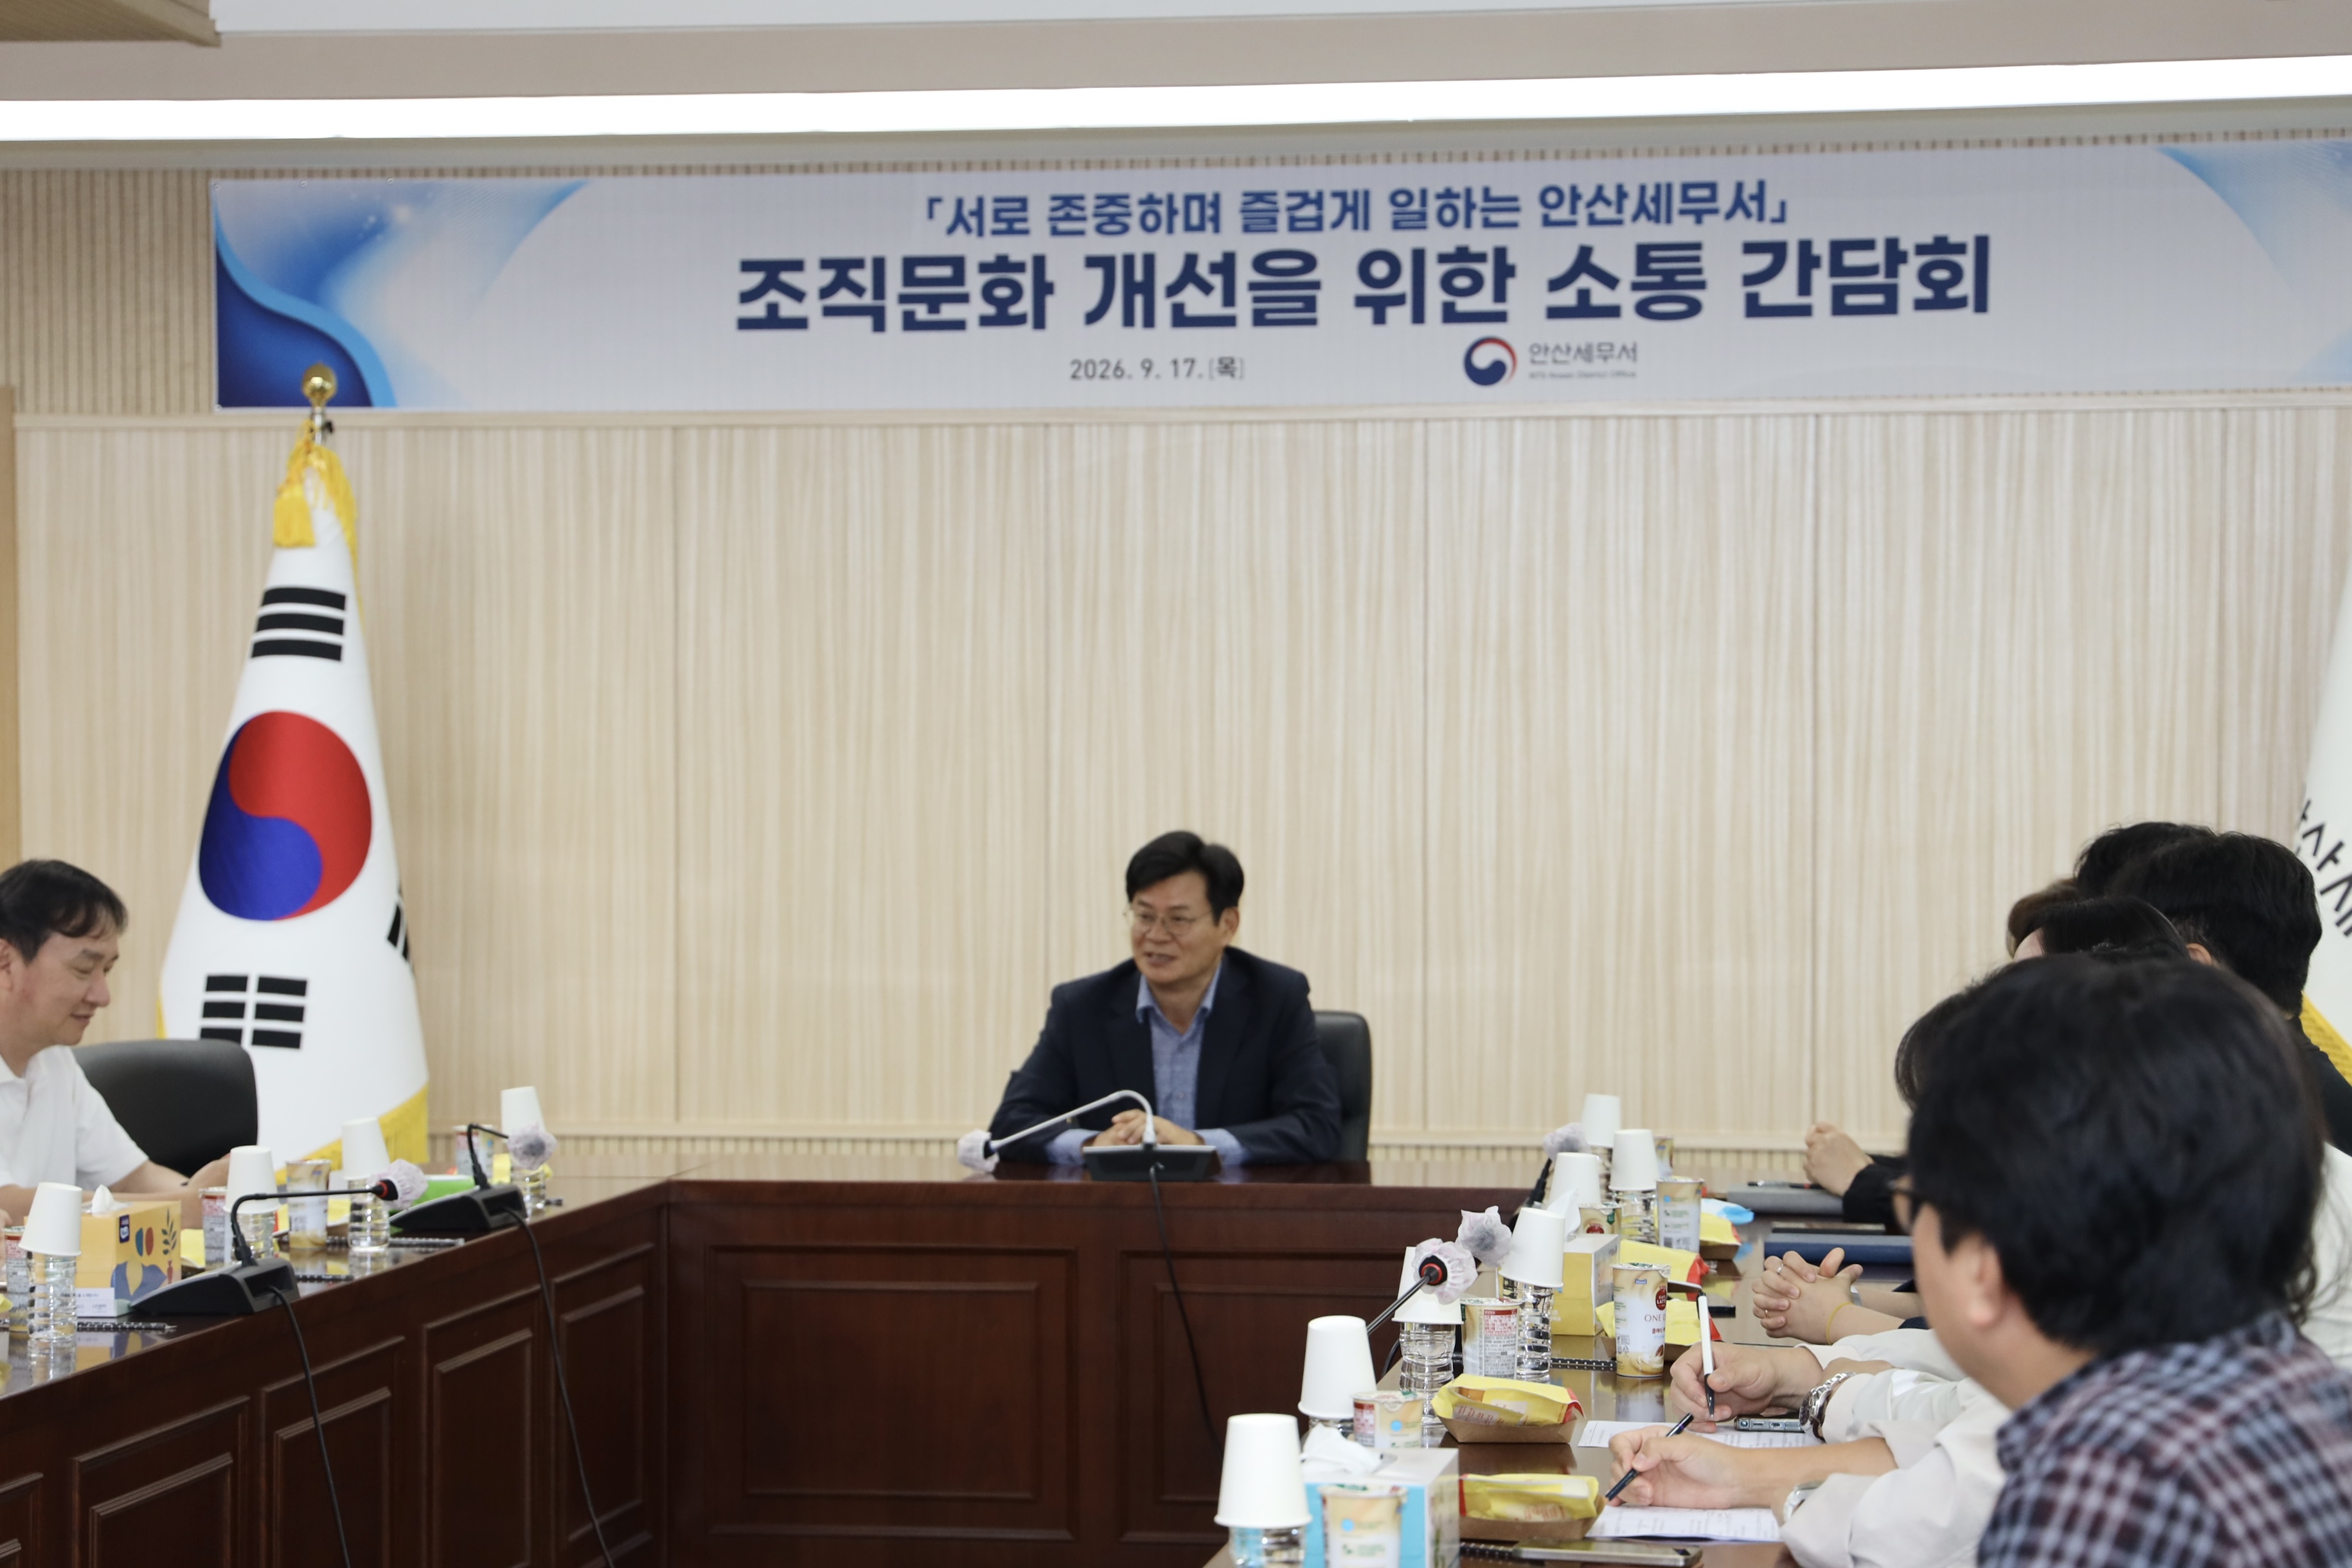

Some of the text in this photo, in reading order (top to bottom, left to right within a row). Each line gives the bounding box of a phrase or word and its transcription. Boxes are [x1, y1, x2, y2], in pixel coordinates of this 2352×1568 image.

[926, 179, 1788, 238] 「서로 존중하며 즐겁게 일하는 안산세무서」
[736, 234, 1991, 334] 조직문화 개선을 위한 소통 간담회
[1528, 341, 1638, 365] 안산세무서
[1069, 359, 1132, 380] 2026.
[1140, 358, 1161, 379] 9.
[1644, 1314, 1662, 1322] ONE
